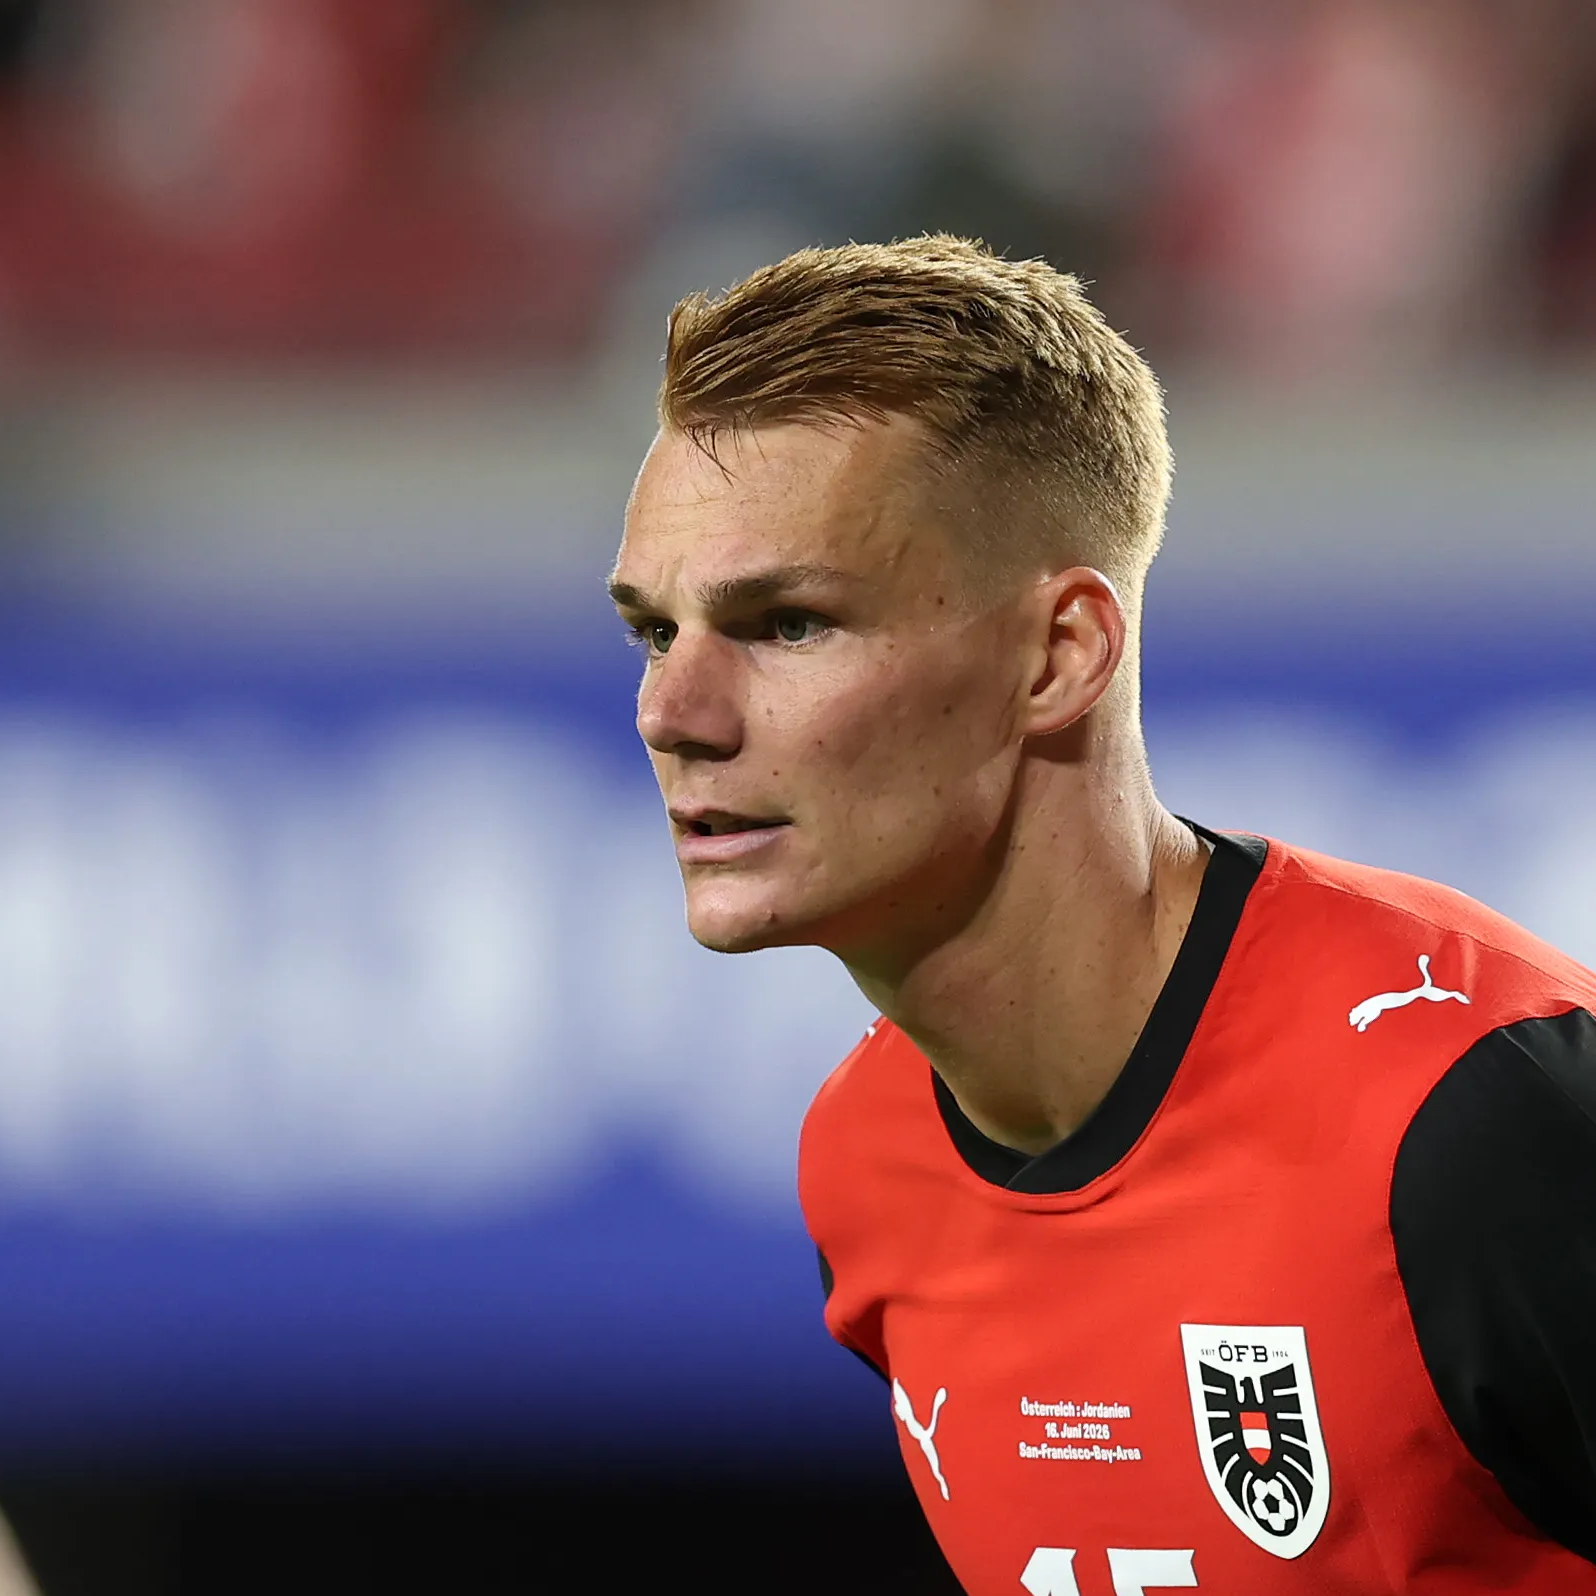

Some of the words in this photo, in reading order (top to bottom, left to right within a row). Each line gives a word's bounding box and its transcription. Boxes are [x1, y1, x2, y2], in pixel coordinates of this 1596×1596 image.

[1218, 1340, 1269, 1363] ÖFB
[1021, 1396, 1075, 1417] Österreich
[1082, 1402, 1131, 1418] Jordanien
[1045, 1422, 1060, 1438] 16.
[1061, 1423, 1082, 1439] Juni
[1083, 1423, 1110, 1440] 2026
[1019, 1441, 1142, 1464] San-Francisco-Bay-Area
